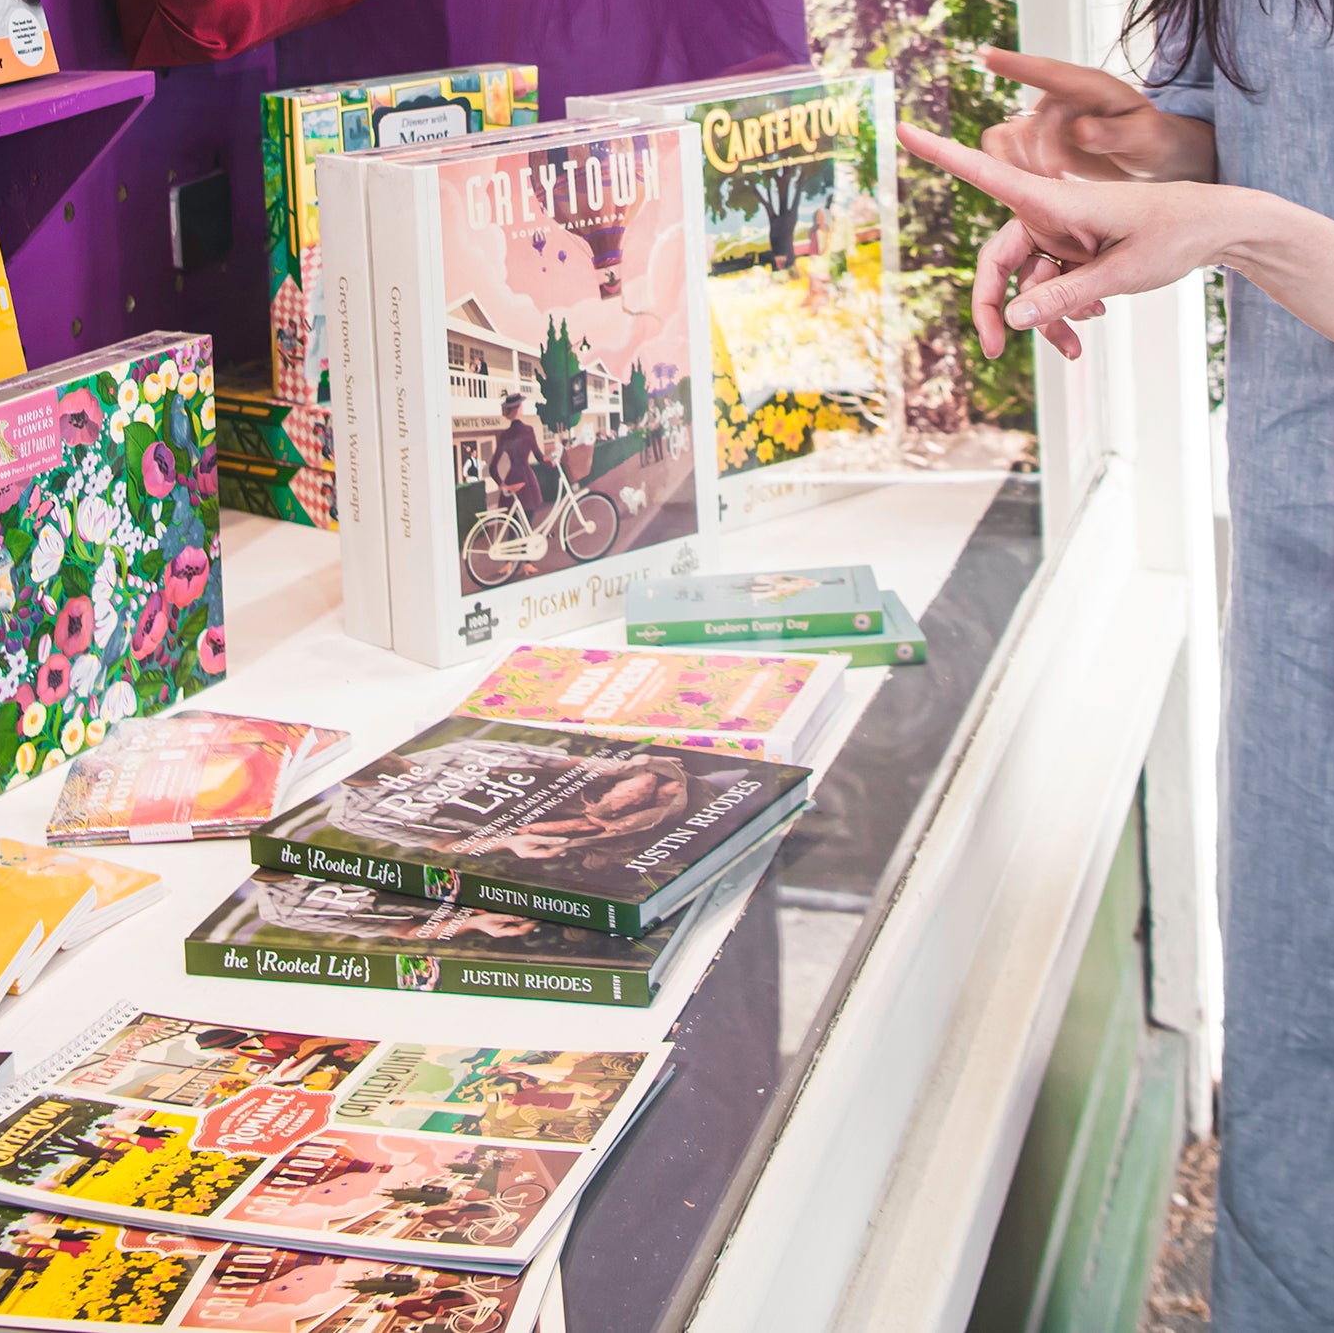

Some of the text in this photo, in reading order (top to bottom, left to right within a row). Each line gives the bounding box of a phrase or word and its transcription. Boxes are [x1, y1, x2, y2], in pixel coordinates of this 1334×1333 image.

[399, 129, 450, 145] Monet
[702, 97, 860, 174] CARTERTON
[467, 148, 660, 229] GREYTOWN
[511, 212, 625, 240] SOUTH WAIRARAPA
[17, 407, 44, 426] BIRDS
[339, 276, 362, 524] Greytown, South Wairarapa
[390, 285, 413, 539] Greytown, South Wairarapa
[13, 417, 54, 440] FLOWERS
[453, 418, 479, 428] WHITE
[518, 587, 582, 629] JIGSAW
[704, 617, 810, 636] Explore Every Day
[557, 666, 615, 705] INDIA
[582, 657, 659, 719] EXPRESS
[378, 763, 433, 793] the
[449, 770, 536, 816] Life
[625, 779, 764, 874] JUSTIN RHODES
[280, 845, 592, 919] the {Rooted Life} JUSTIN RHODES
[224, 948, 593, 993] the {Rooted Life} JUSTIN RHODES
[71, 1019, 170, 1087] FEATHERSTON
[336, 1047, 428, 1119] CASTLEPOINT
[216, 1091, 296, 1147] ROMANCE
[279, 1108, 316, 1138] CALENDAR
